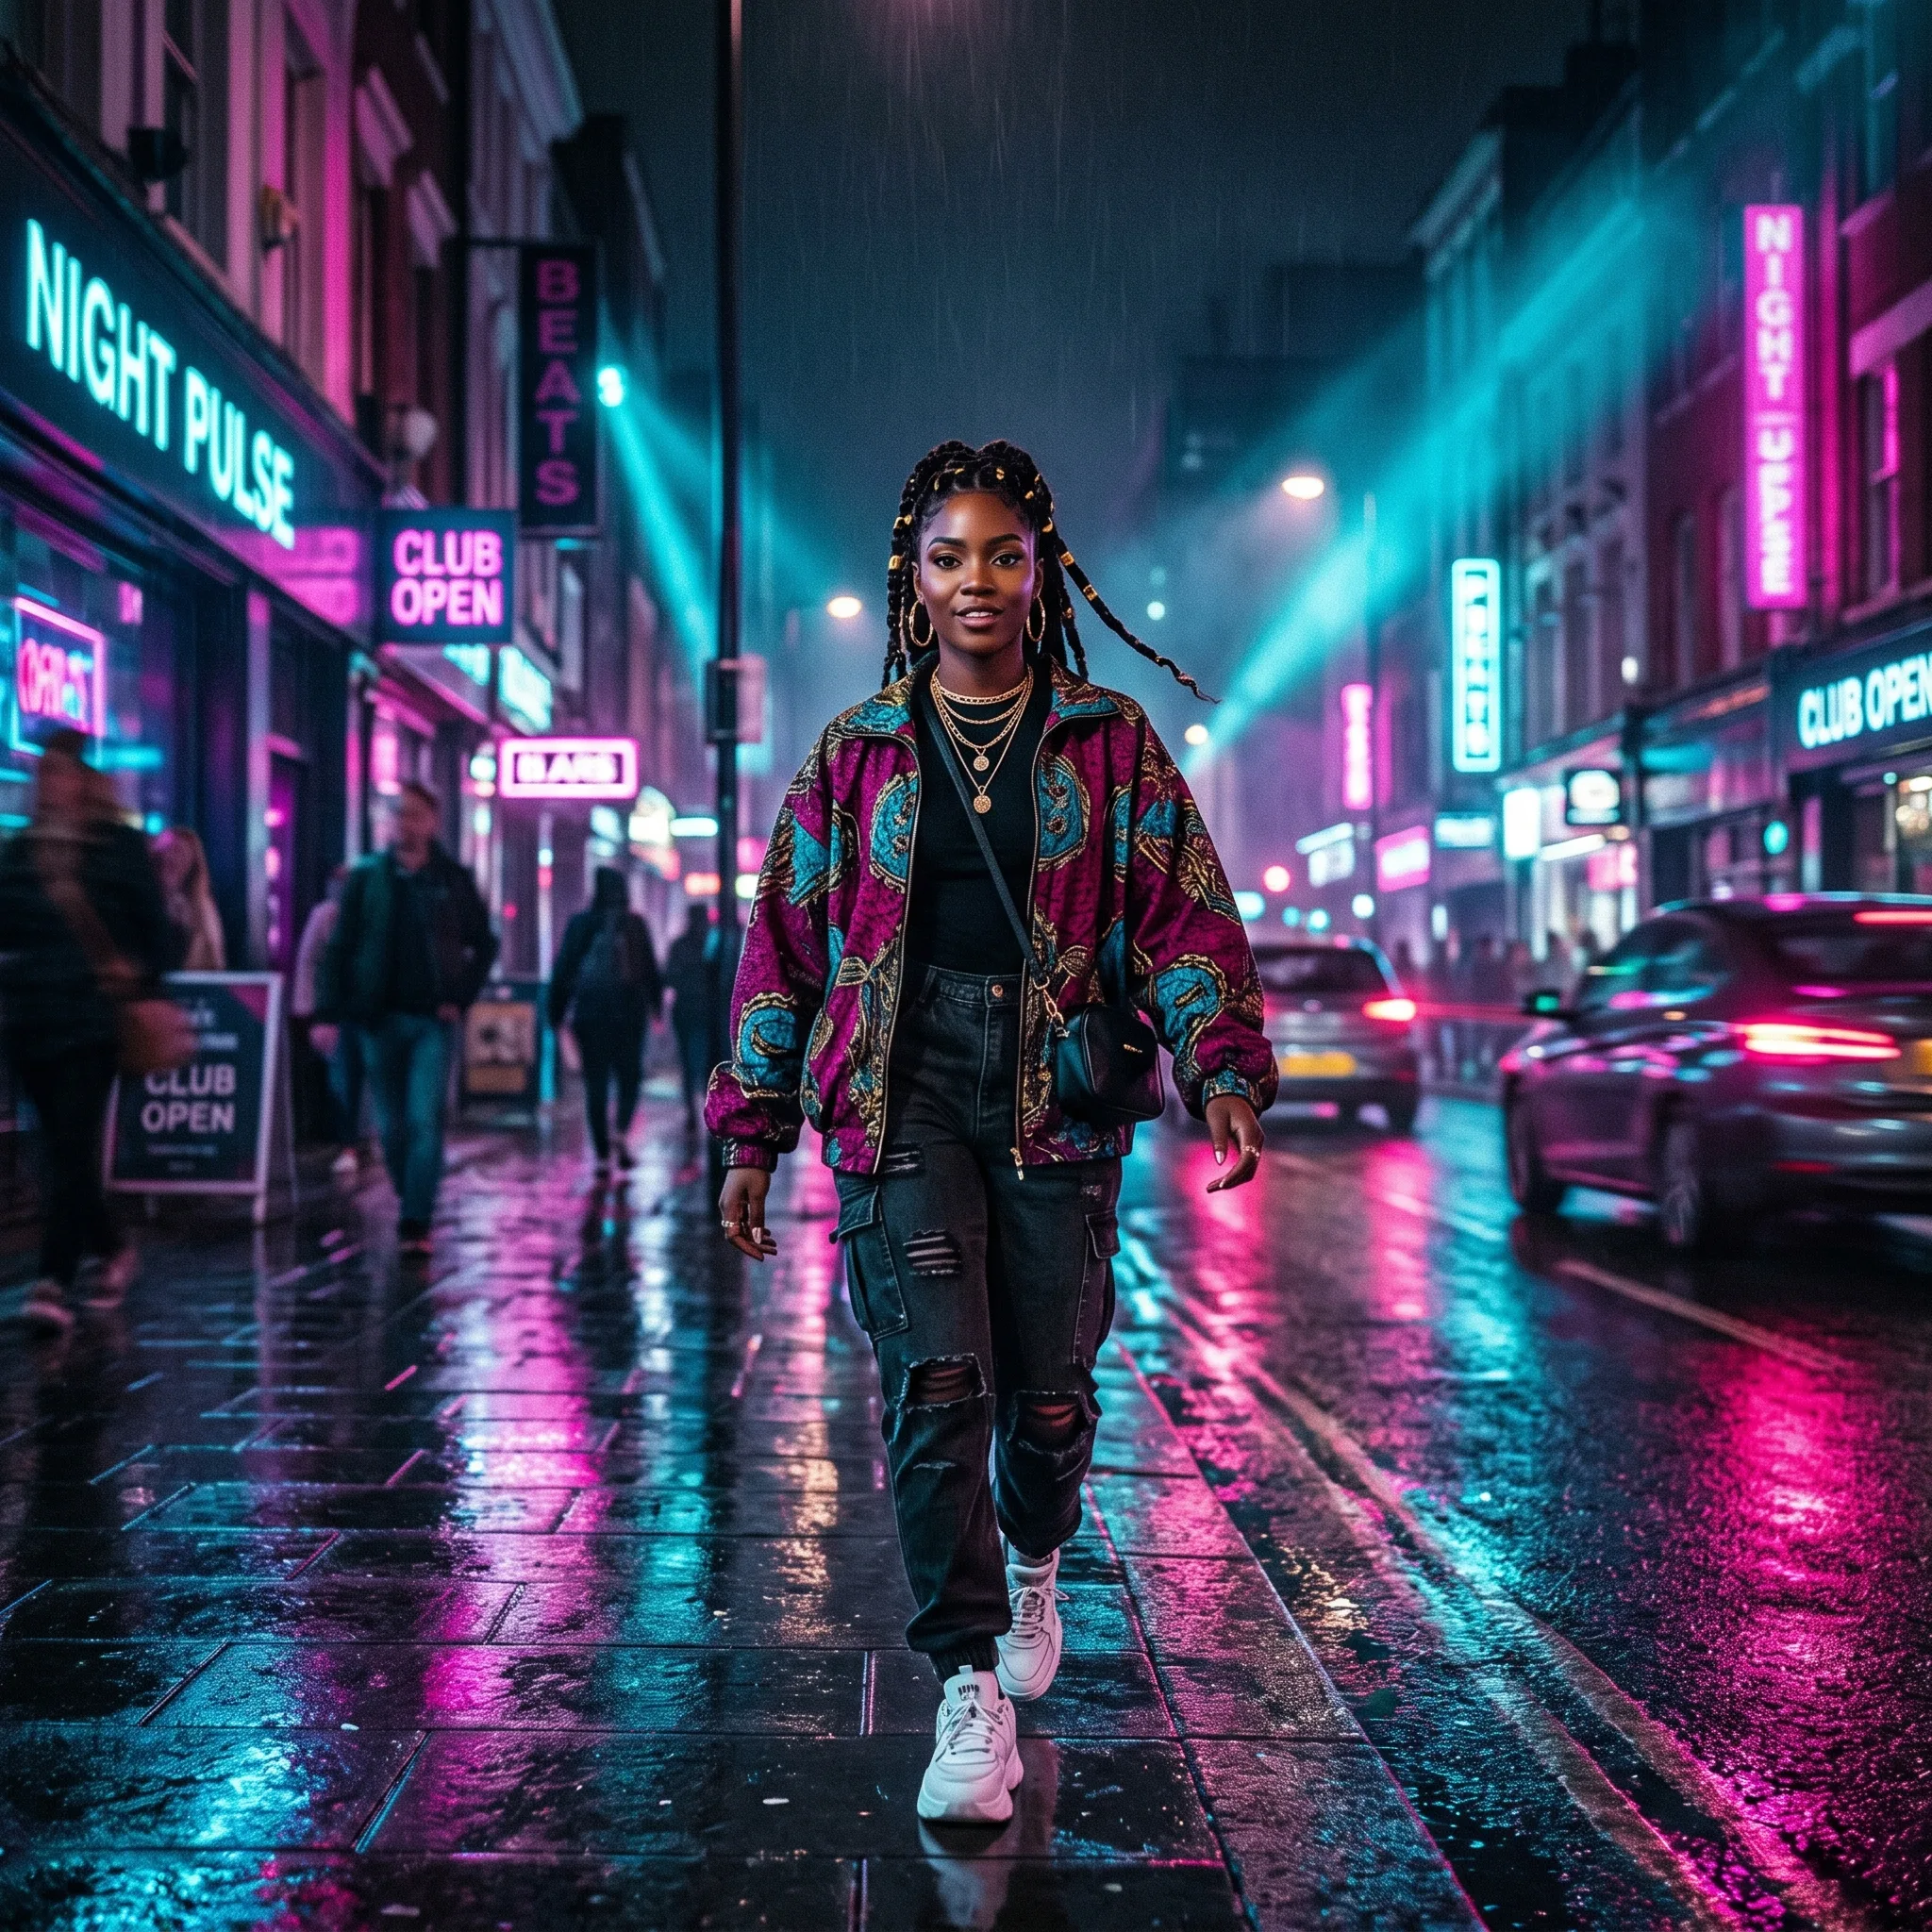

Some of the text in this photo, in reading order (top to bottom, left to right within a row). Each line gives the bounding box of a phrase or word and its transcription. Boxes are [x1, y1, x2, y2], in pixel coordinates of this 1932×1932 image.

[1756, 214, 1791, 401] NIGHT
[26, 218, 294, 551] NIGHT PULSE
[534, 258, 581, 507] BEATS
[393, 528, 503, 576] CLUB
[391, 576, 503, 626] OPEN
[1798, 651, 1932, 749] CLUB OPEN
[141, 1100, 236, 1133] OPEN
[143, 1063, 237, 1096] CLUB
